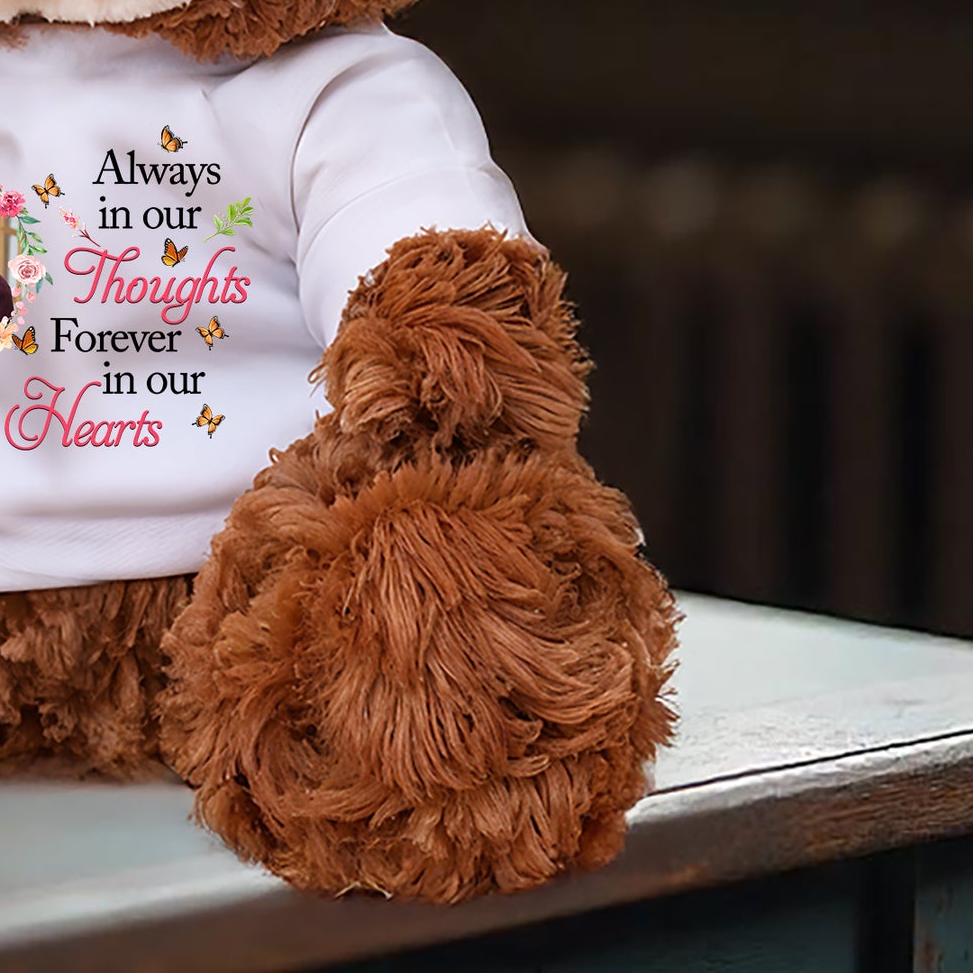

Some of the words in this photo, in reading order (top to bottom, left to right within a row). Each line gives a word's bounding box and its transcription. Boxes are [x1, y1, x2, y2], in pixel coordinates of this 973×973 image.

[92, 148, 221, 197] Always
[98, 195, 133, 229] in
[142, 206, 202, 230] our
[64, 246, 251, 325] Thoughts
[50, 317, 182, 353] Forever
[102, 361, 137, 395] in
[146, 371, 206, 395] our
[4, 376, 163, 450] Hearts
